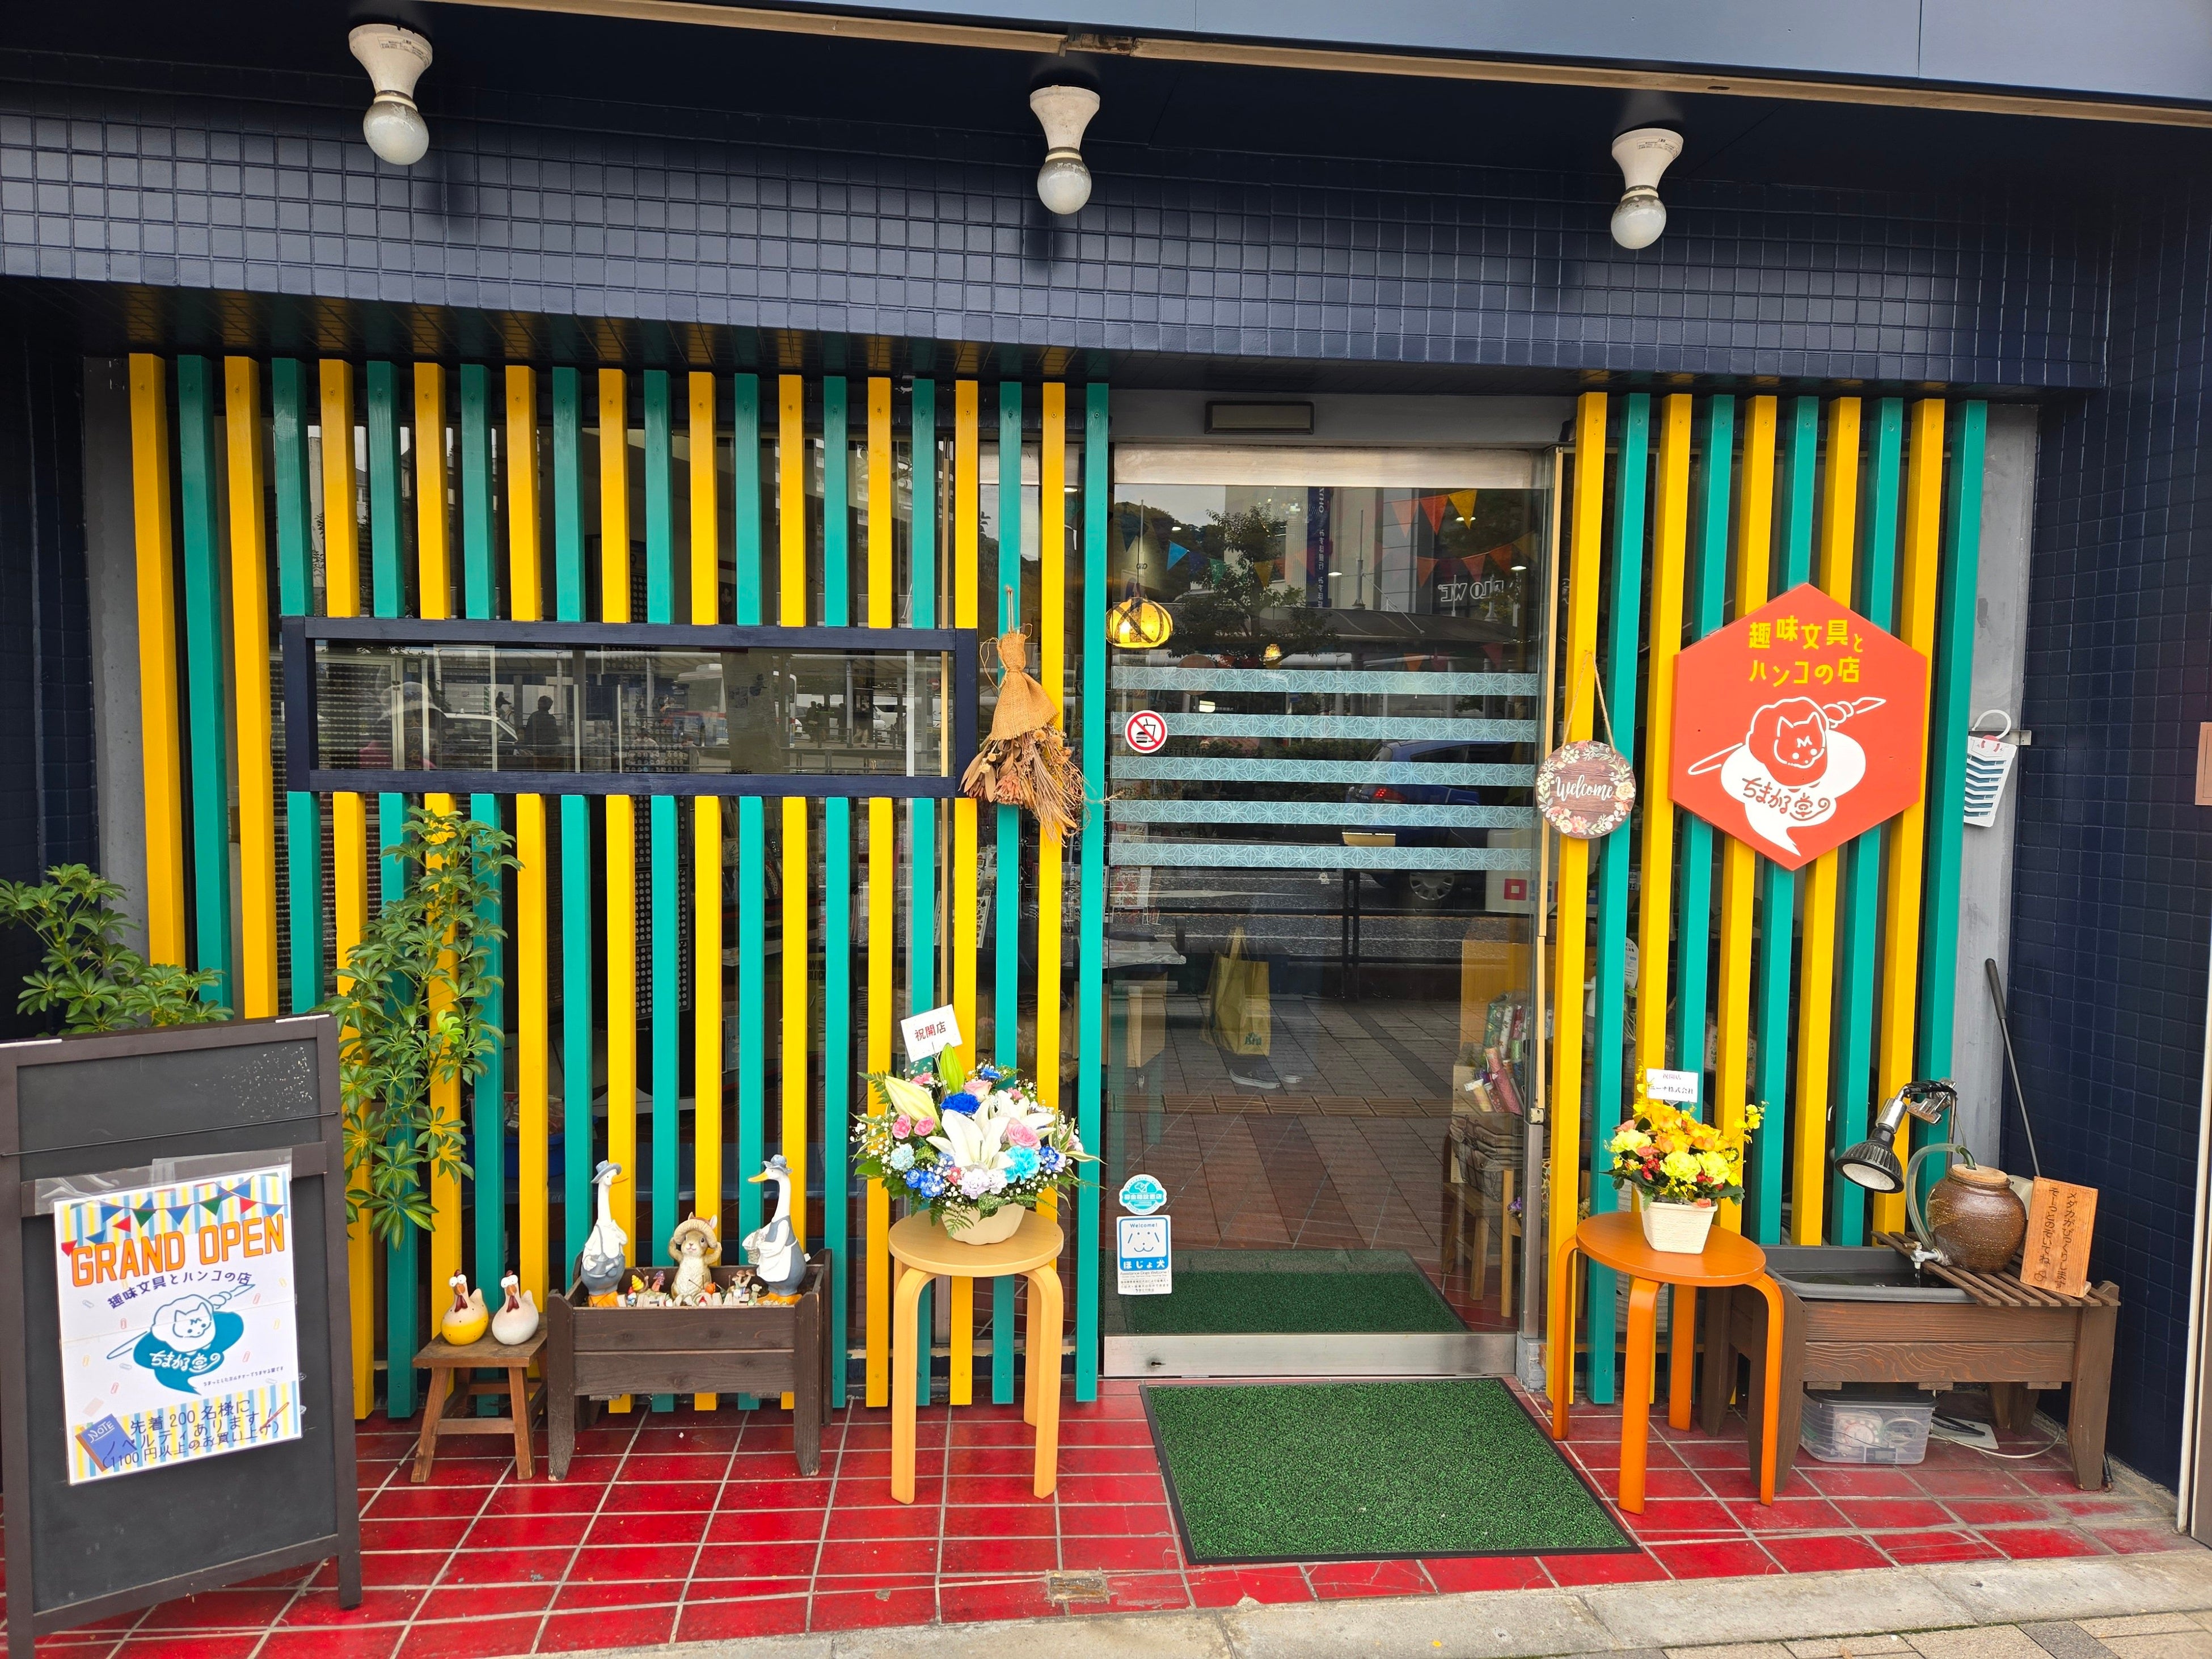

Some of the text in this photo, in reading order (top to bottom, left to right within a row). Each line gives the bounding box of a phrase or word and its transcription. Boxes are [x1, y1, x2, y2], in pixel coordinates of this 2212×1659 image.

[1749, 615, 1863, 653] 趣味文具と
[1749, 656, 1859, 687] ハンコの店
[1555, 774, 1614, 801] Welcome
[914, 1021, 946, 1041] 祝開店
[2038, 1187, 2059, 1265] そーっとのぞいてね
[2054, 1192, 2078, 1289] メダカがびっくりします
[71, 1214, 285, 1287] GRAND OPEN
[1123, 1259, 1165, 1270] ほじょ犬
[107, 1270, 252, 1308] 趣味文具とハンコの店
